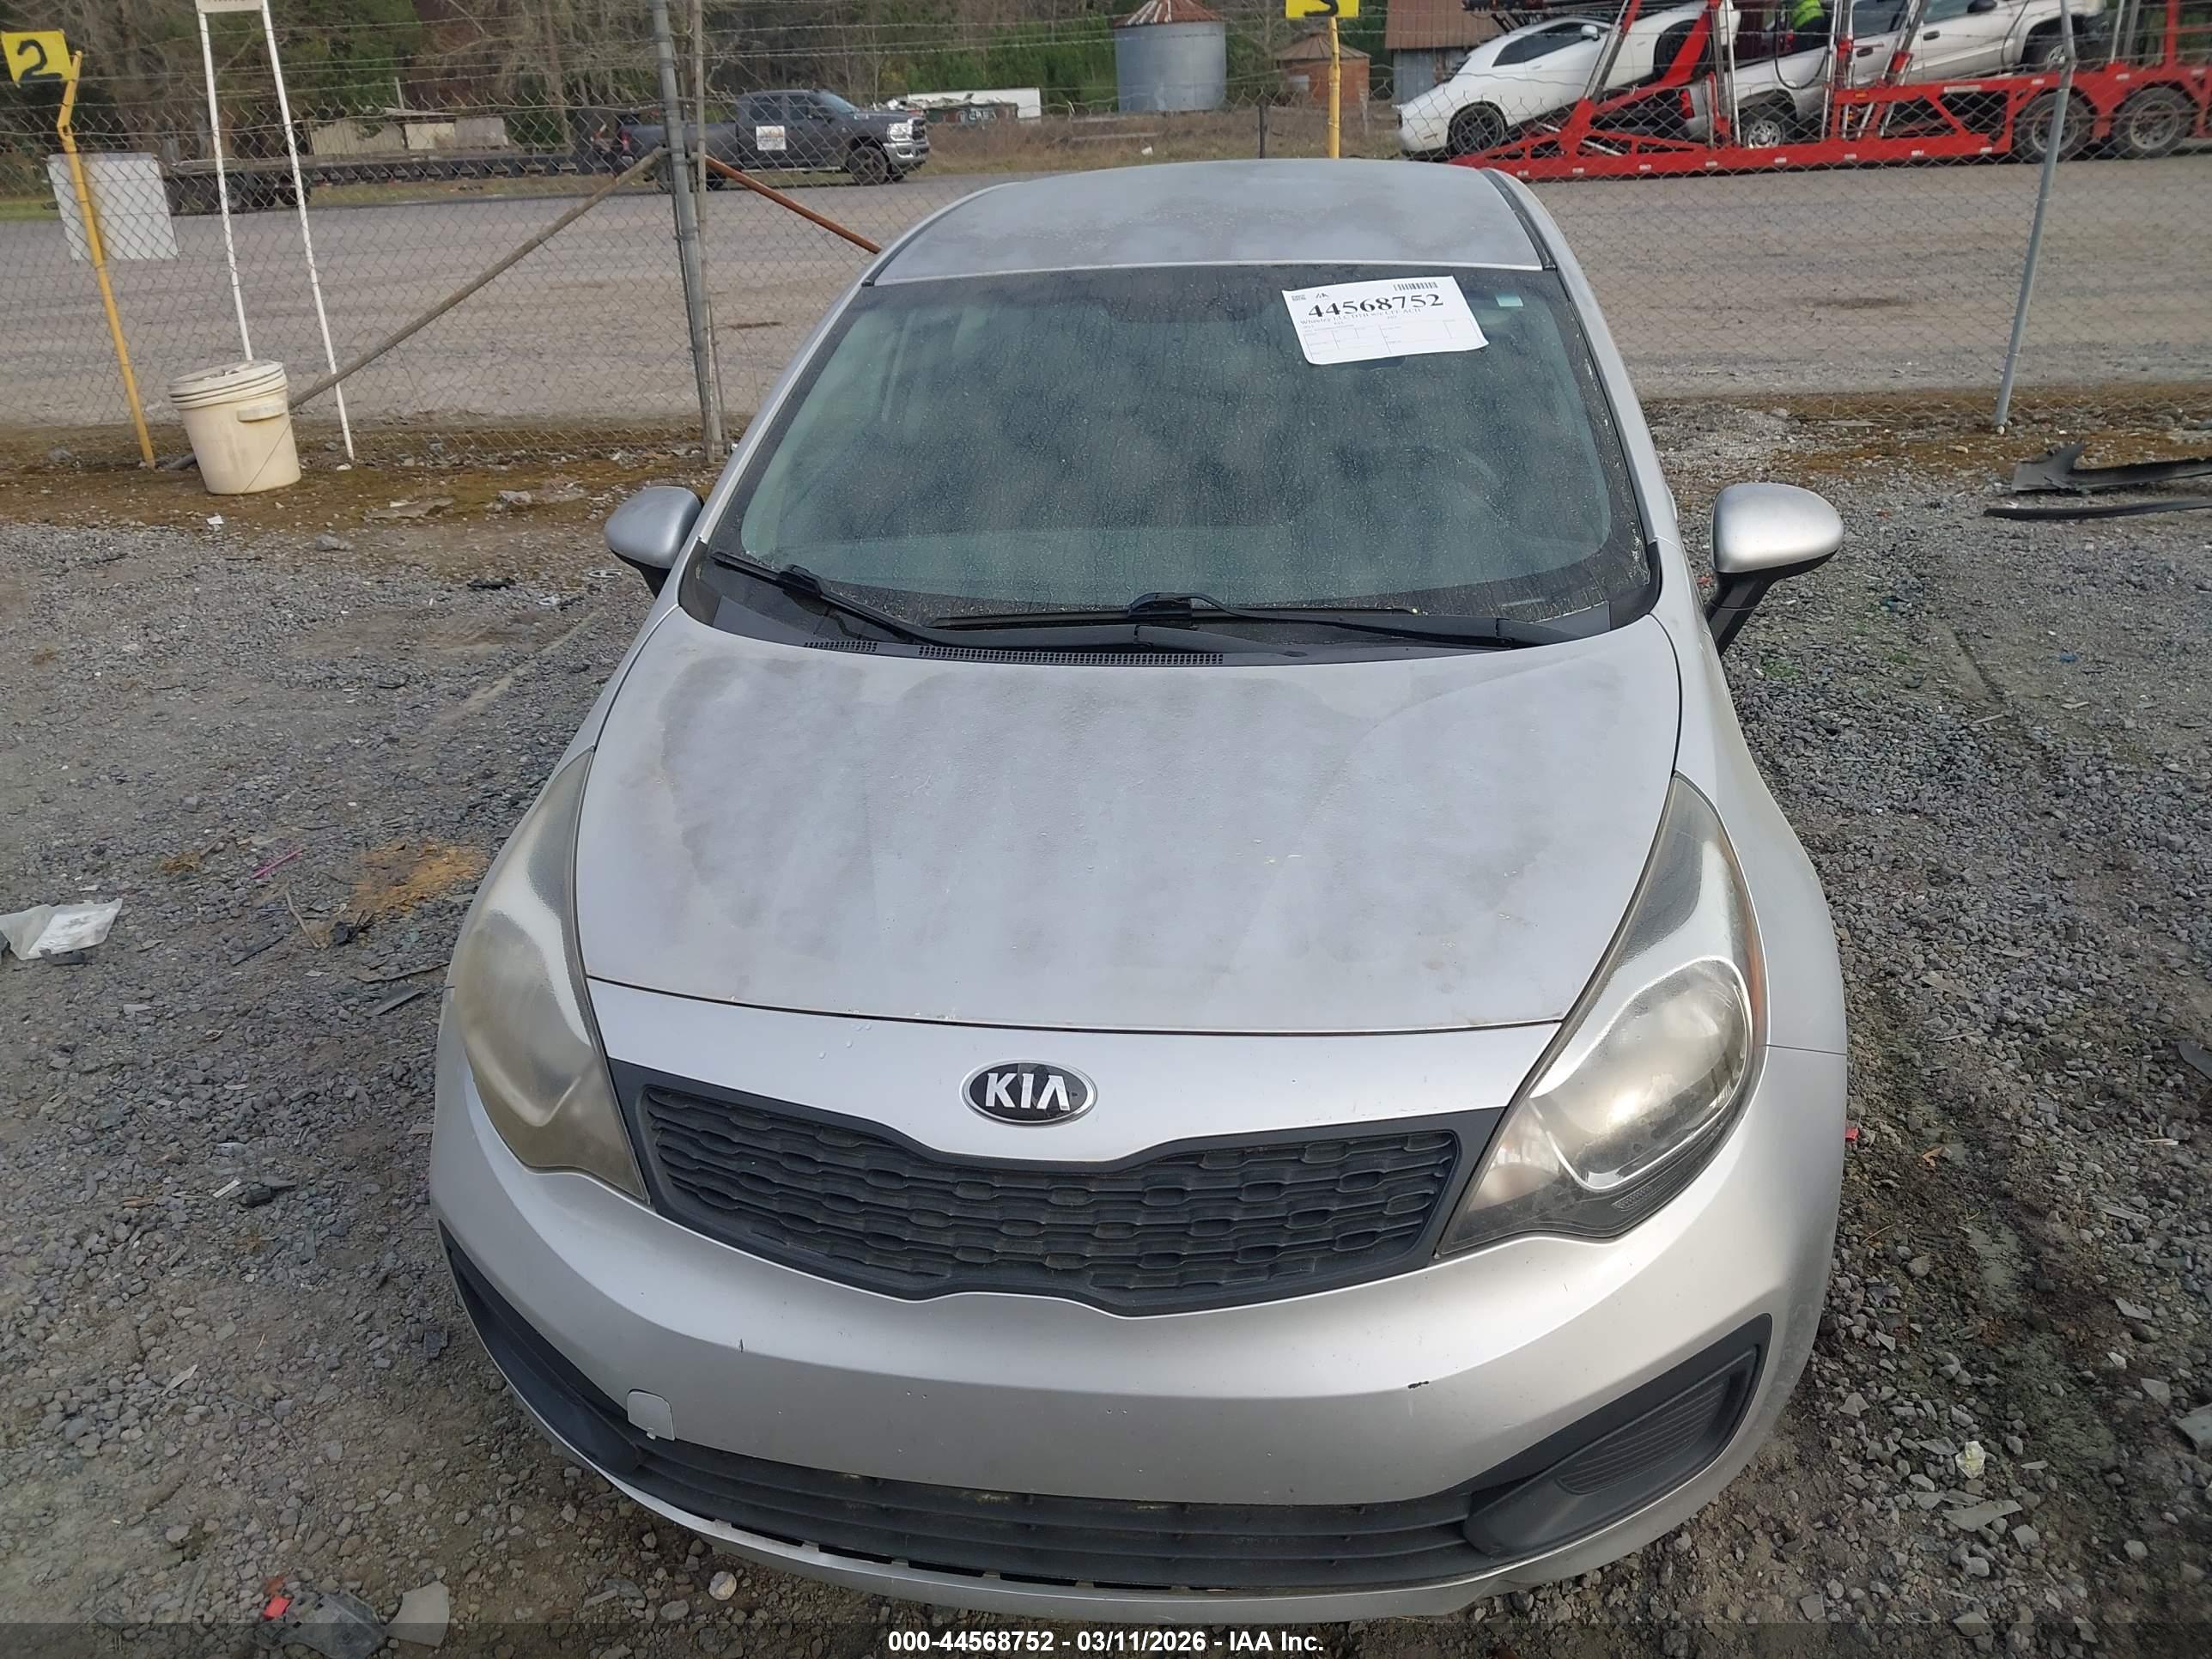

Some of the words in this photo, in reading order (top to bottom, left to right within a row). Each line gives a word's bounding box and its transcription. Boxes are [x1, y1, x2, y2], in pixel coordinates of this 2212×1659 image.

[17, 40, 63, 83] 2
[1308, 294, 1444, 318] 44568752
[985, 1073, 1071, 1111] KIA
